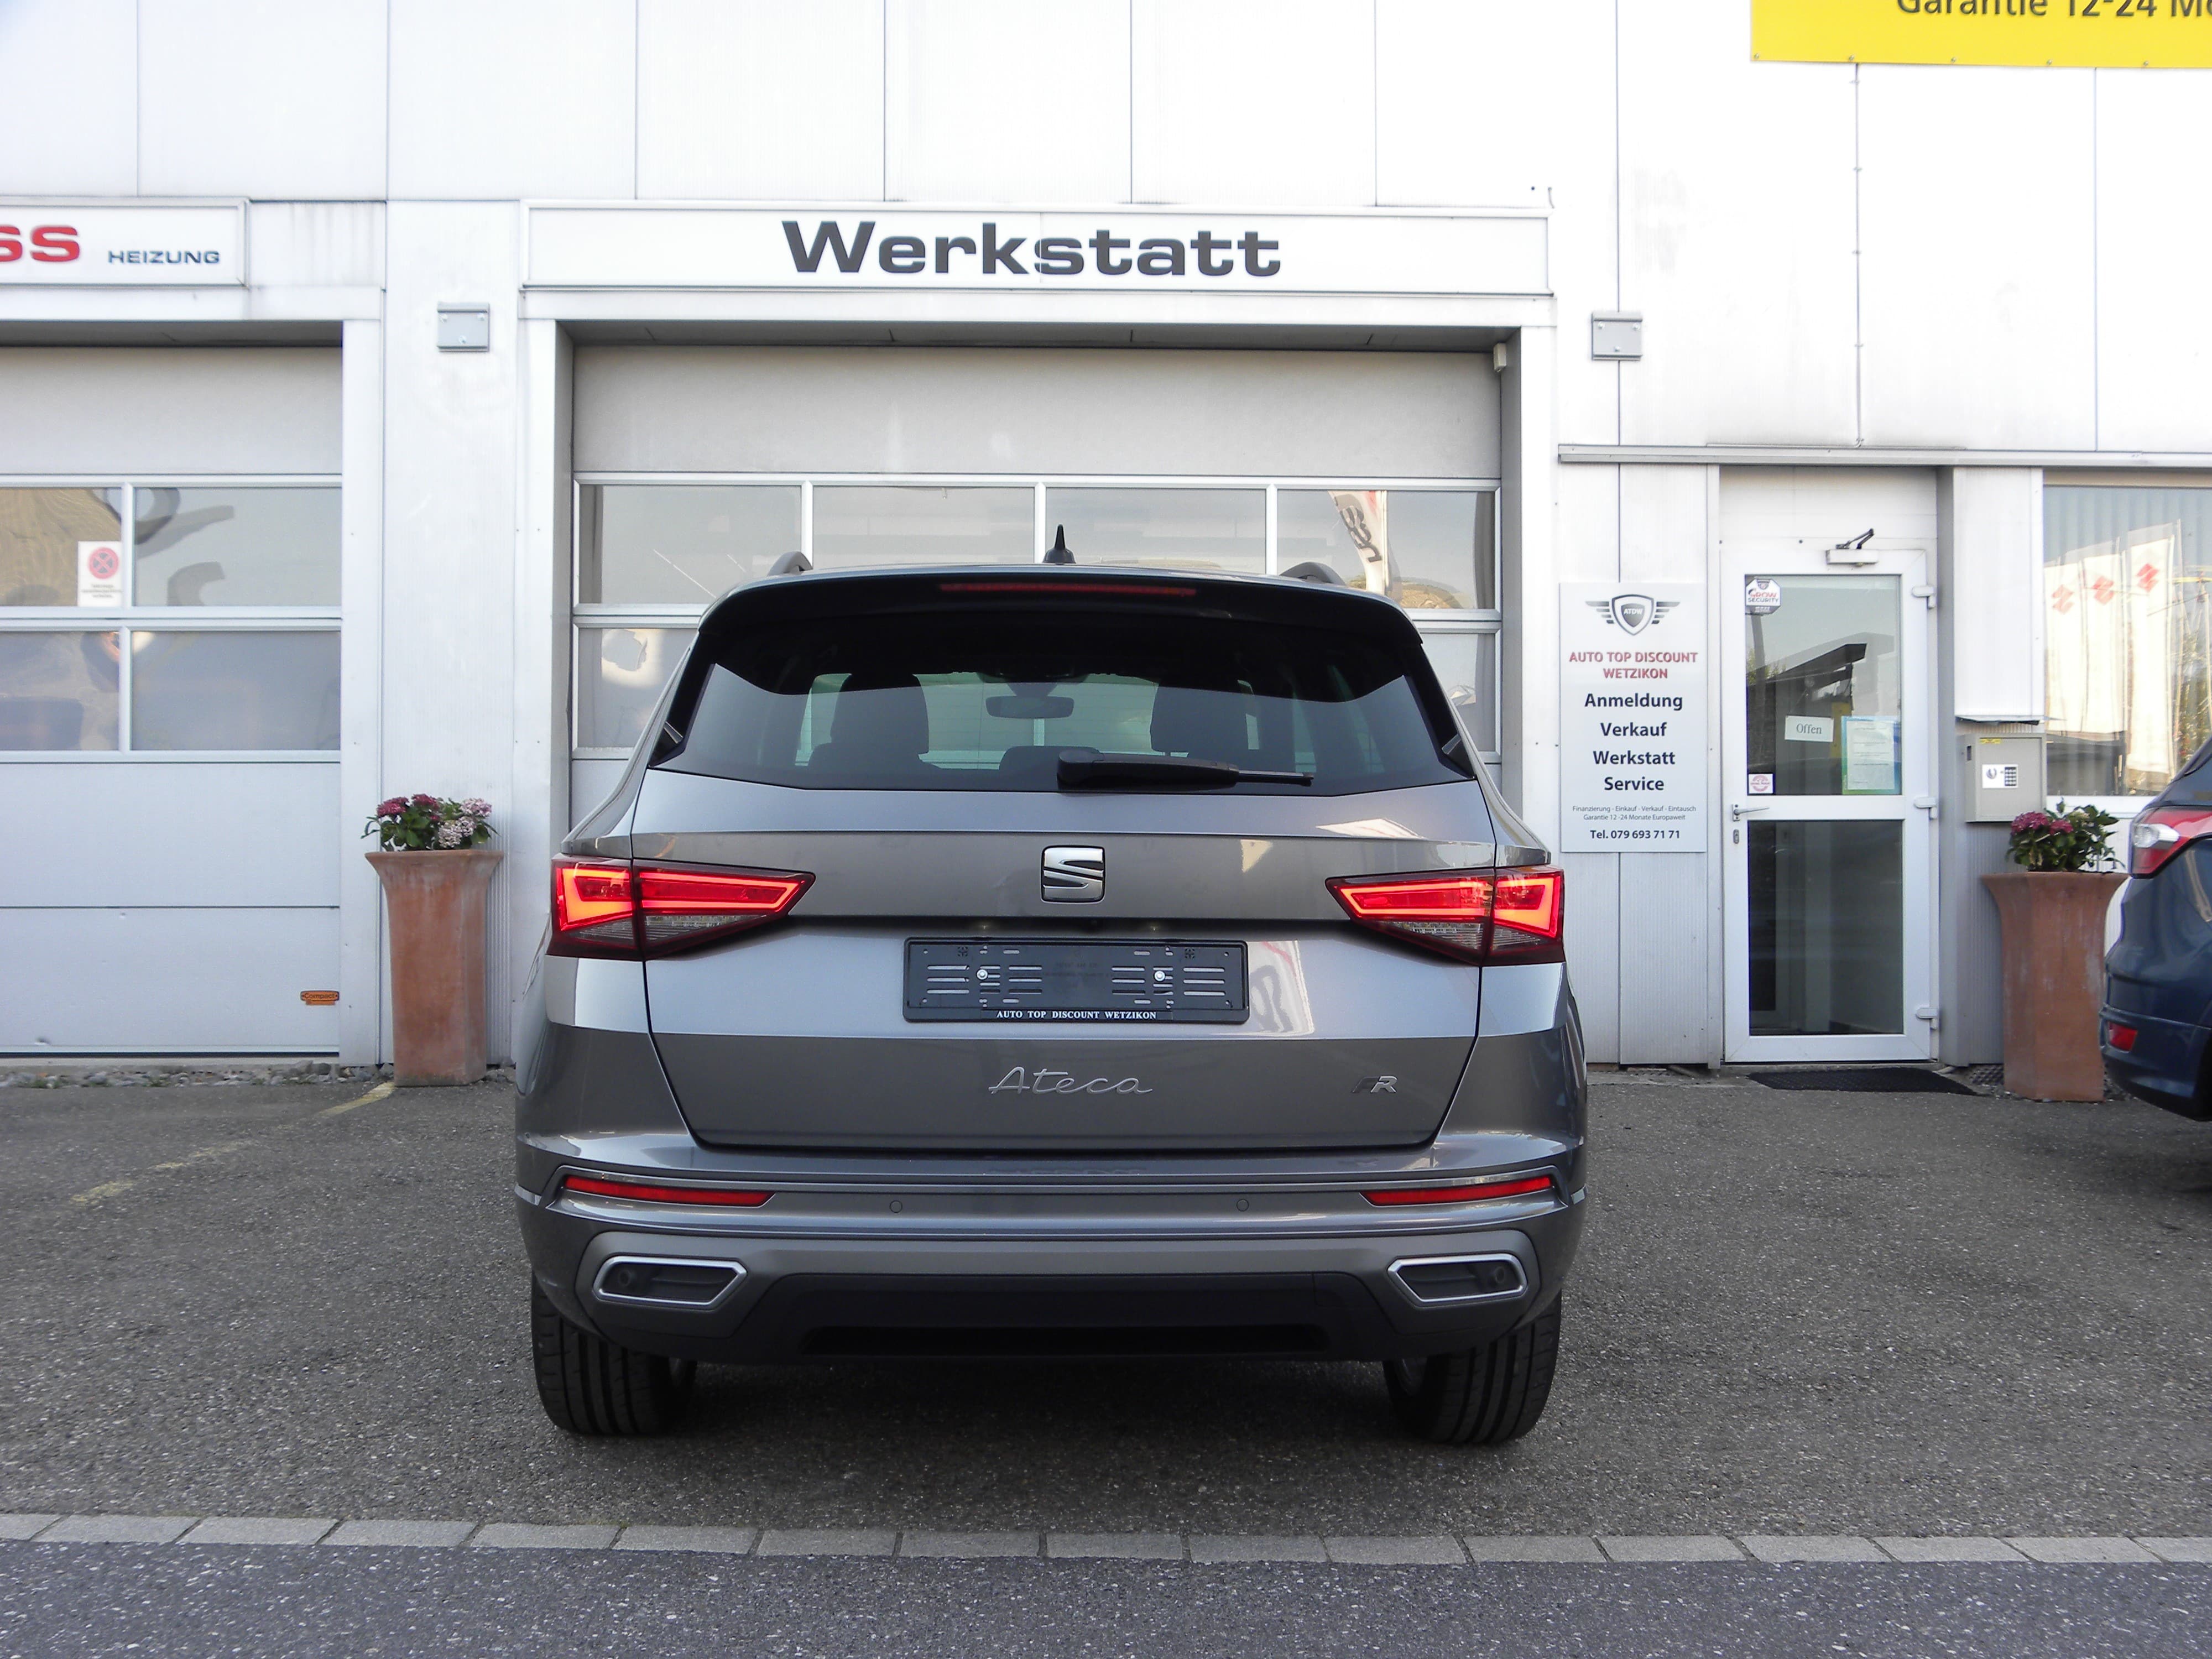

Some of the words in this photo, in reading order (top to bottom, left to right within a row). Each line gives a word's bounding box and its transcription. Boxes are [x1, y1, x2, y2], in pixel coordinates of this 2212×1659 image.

[782, 221, 1280, 277] Werkstatt
[108, 251, 220, 264] HEIZUNG
[1569, 651, 1603, 662] AUTO
[1606, 651, 1631, 663] TOP
[1635, 652, 1698, 663] DISCOUNT
[1603, 668, 1668, 679] WETZIKON
[1584, 693, 1683, 711] Anmeldung
[1600, 722, 1667, 737] Verkauf
[1796, 723, 1822, 734] Offen
[1593, 750, 1676, 765] Werkstatt
[1604, 776, 1665, 791] Service
[1590, 830, 1609, 839] Tel.
[1610, 830, 1630, 839] 079
[1632, 830, 1651, 839] 693
[1653, 830, 1665, 839] 71
[1668, 830, 1679, 839] 71
[1104, 1011, 1156, 1019] WETZIKON
[988, 1066, 1153, 1095] Ateca
